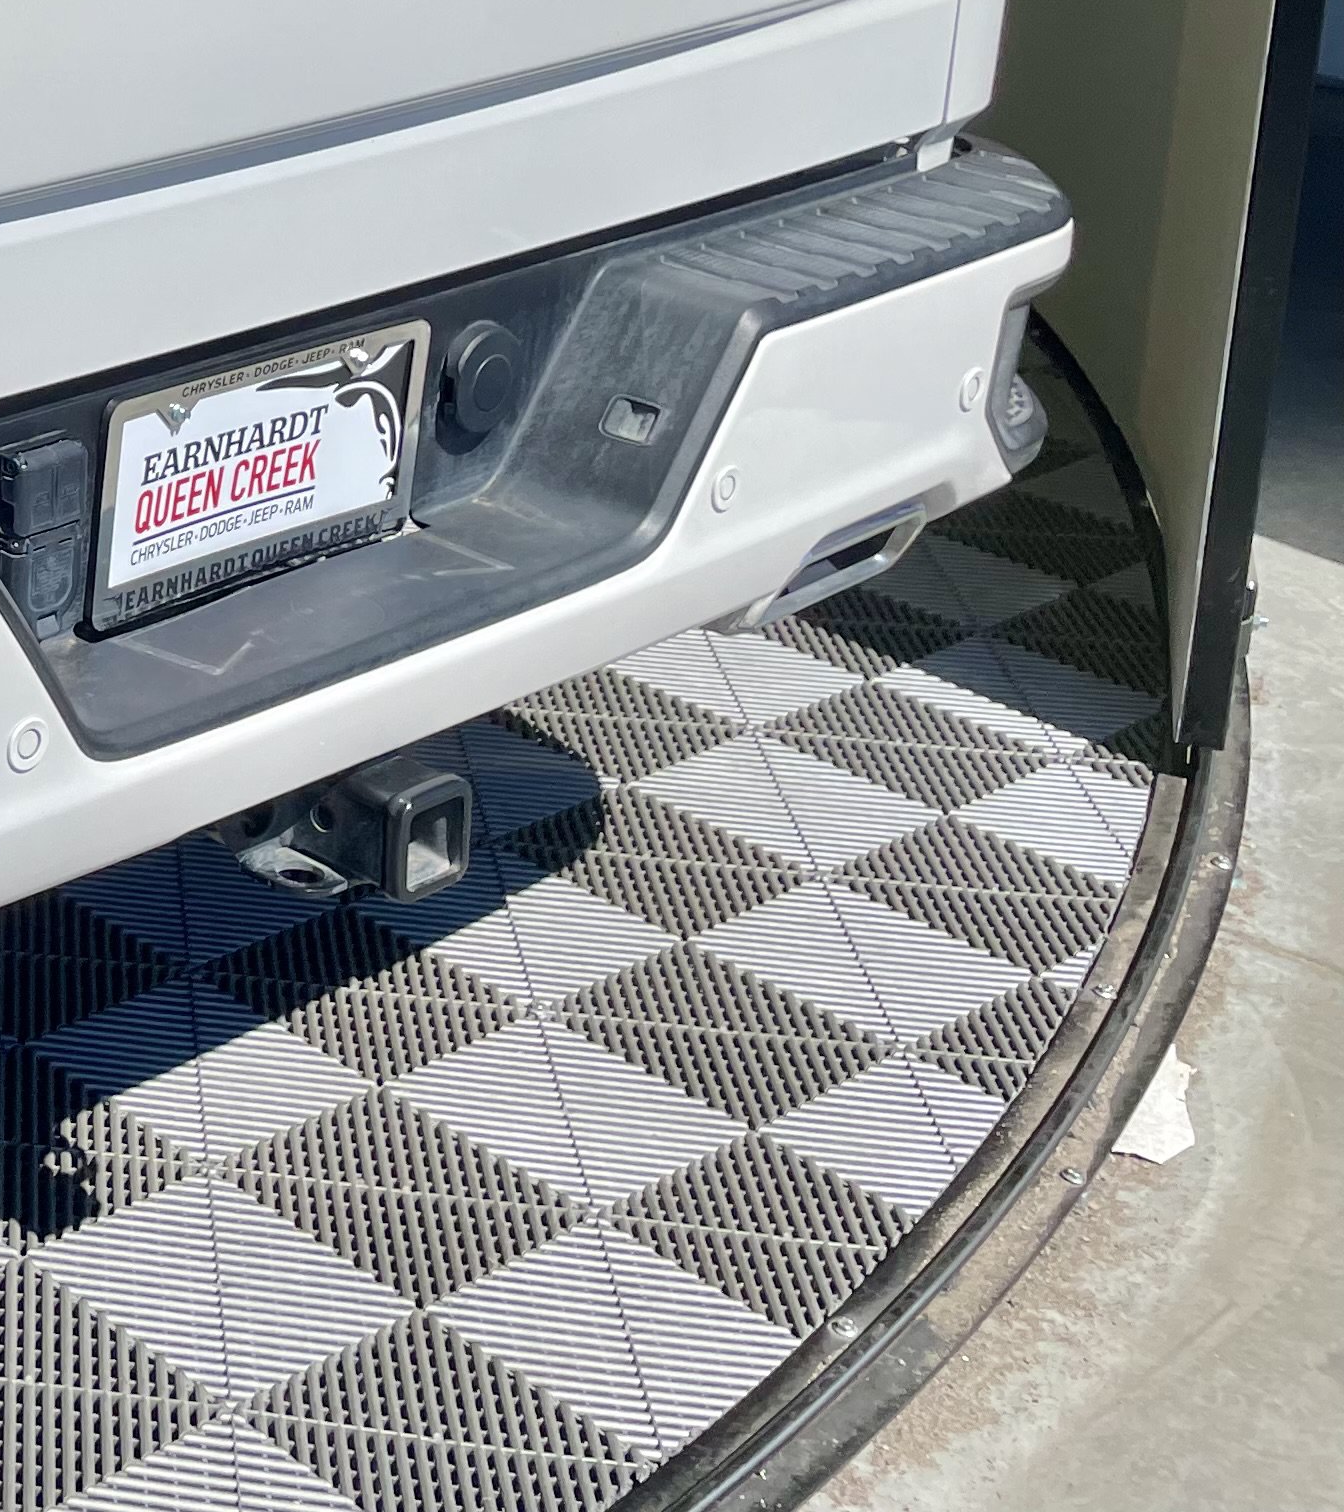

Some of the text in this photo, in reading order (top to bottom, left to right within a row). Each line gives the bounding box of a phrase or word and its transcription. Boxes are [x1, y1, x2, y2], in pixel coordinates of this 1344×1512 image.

[182, 373, 245, 398] CHRYSLER
[254, 357, 294, 379] DODGE
[302, 348, 331, 365] JEEP
[134, 438, 322, 534] QUEEN CREEK
[140, 403, 330, 486] EARNHARDT
